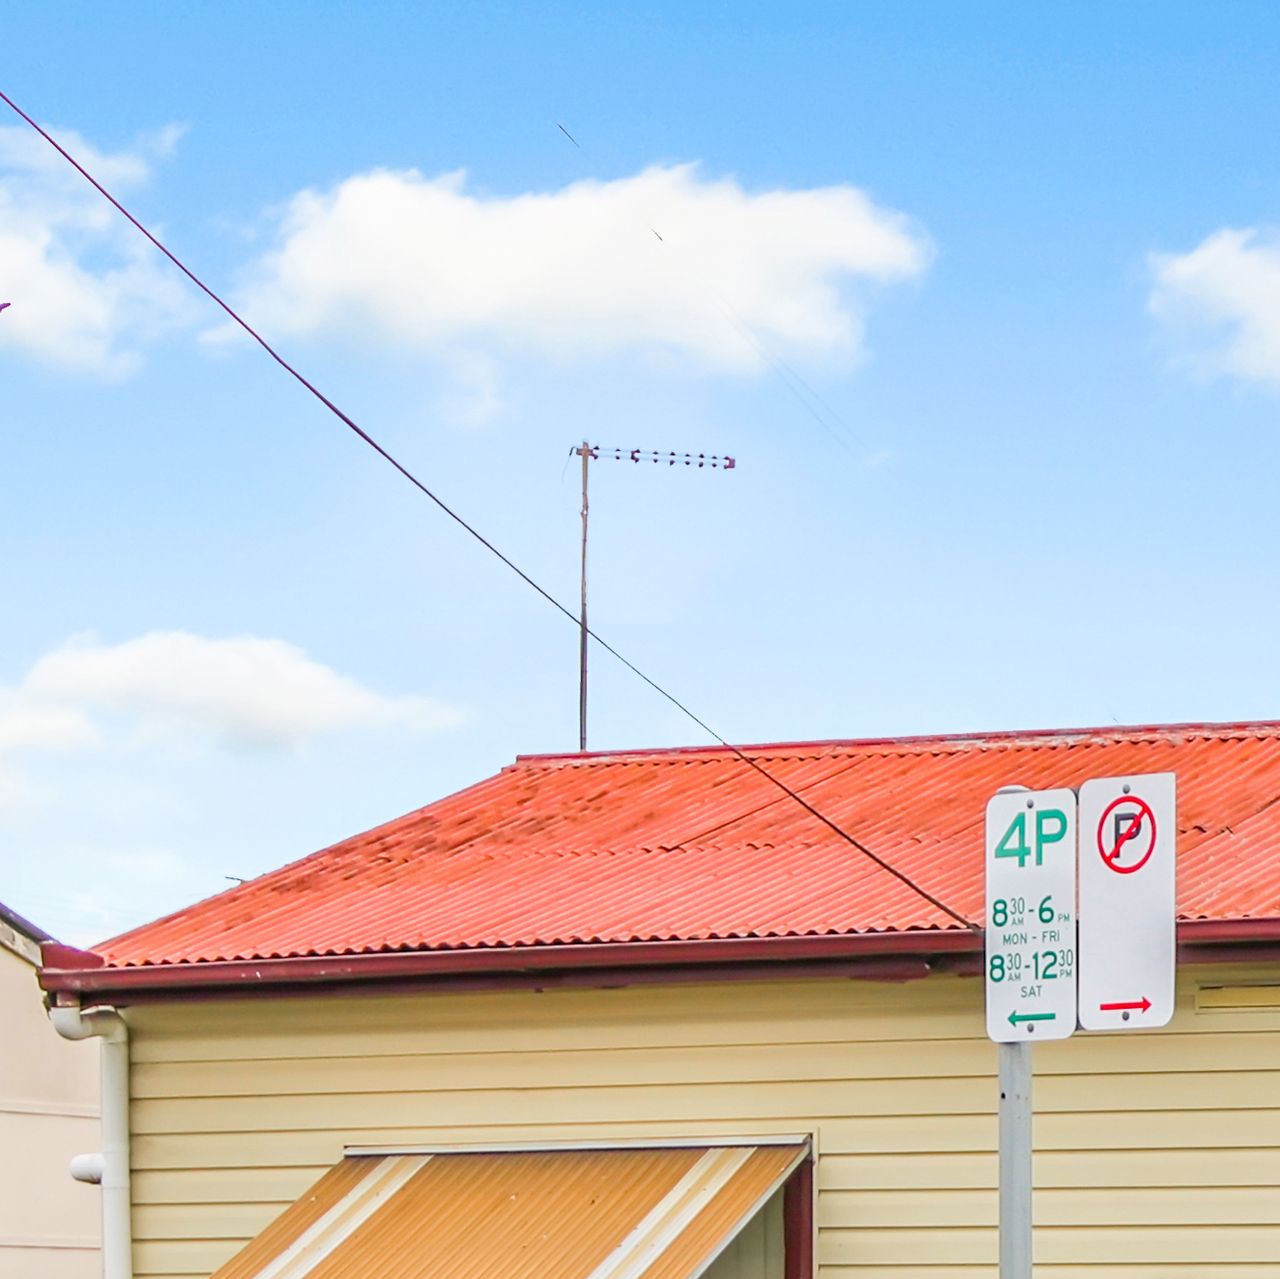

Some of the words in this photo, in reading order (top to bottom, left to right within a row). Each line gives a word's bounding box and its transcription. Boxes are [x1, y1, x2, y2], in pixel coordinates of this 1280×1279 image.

[994, 808, 1068, 868] 4P
[1113, 812, 1142, 859] P
[1057, 913, 1070, 922] PM
[1003, 933, 1028, 945] MON
[1042, 930, 1060, 943] FRI
[1059, 969, 1073, 979] PM
[1020, 985, 1042, 998] SAT
